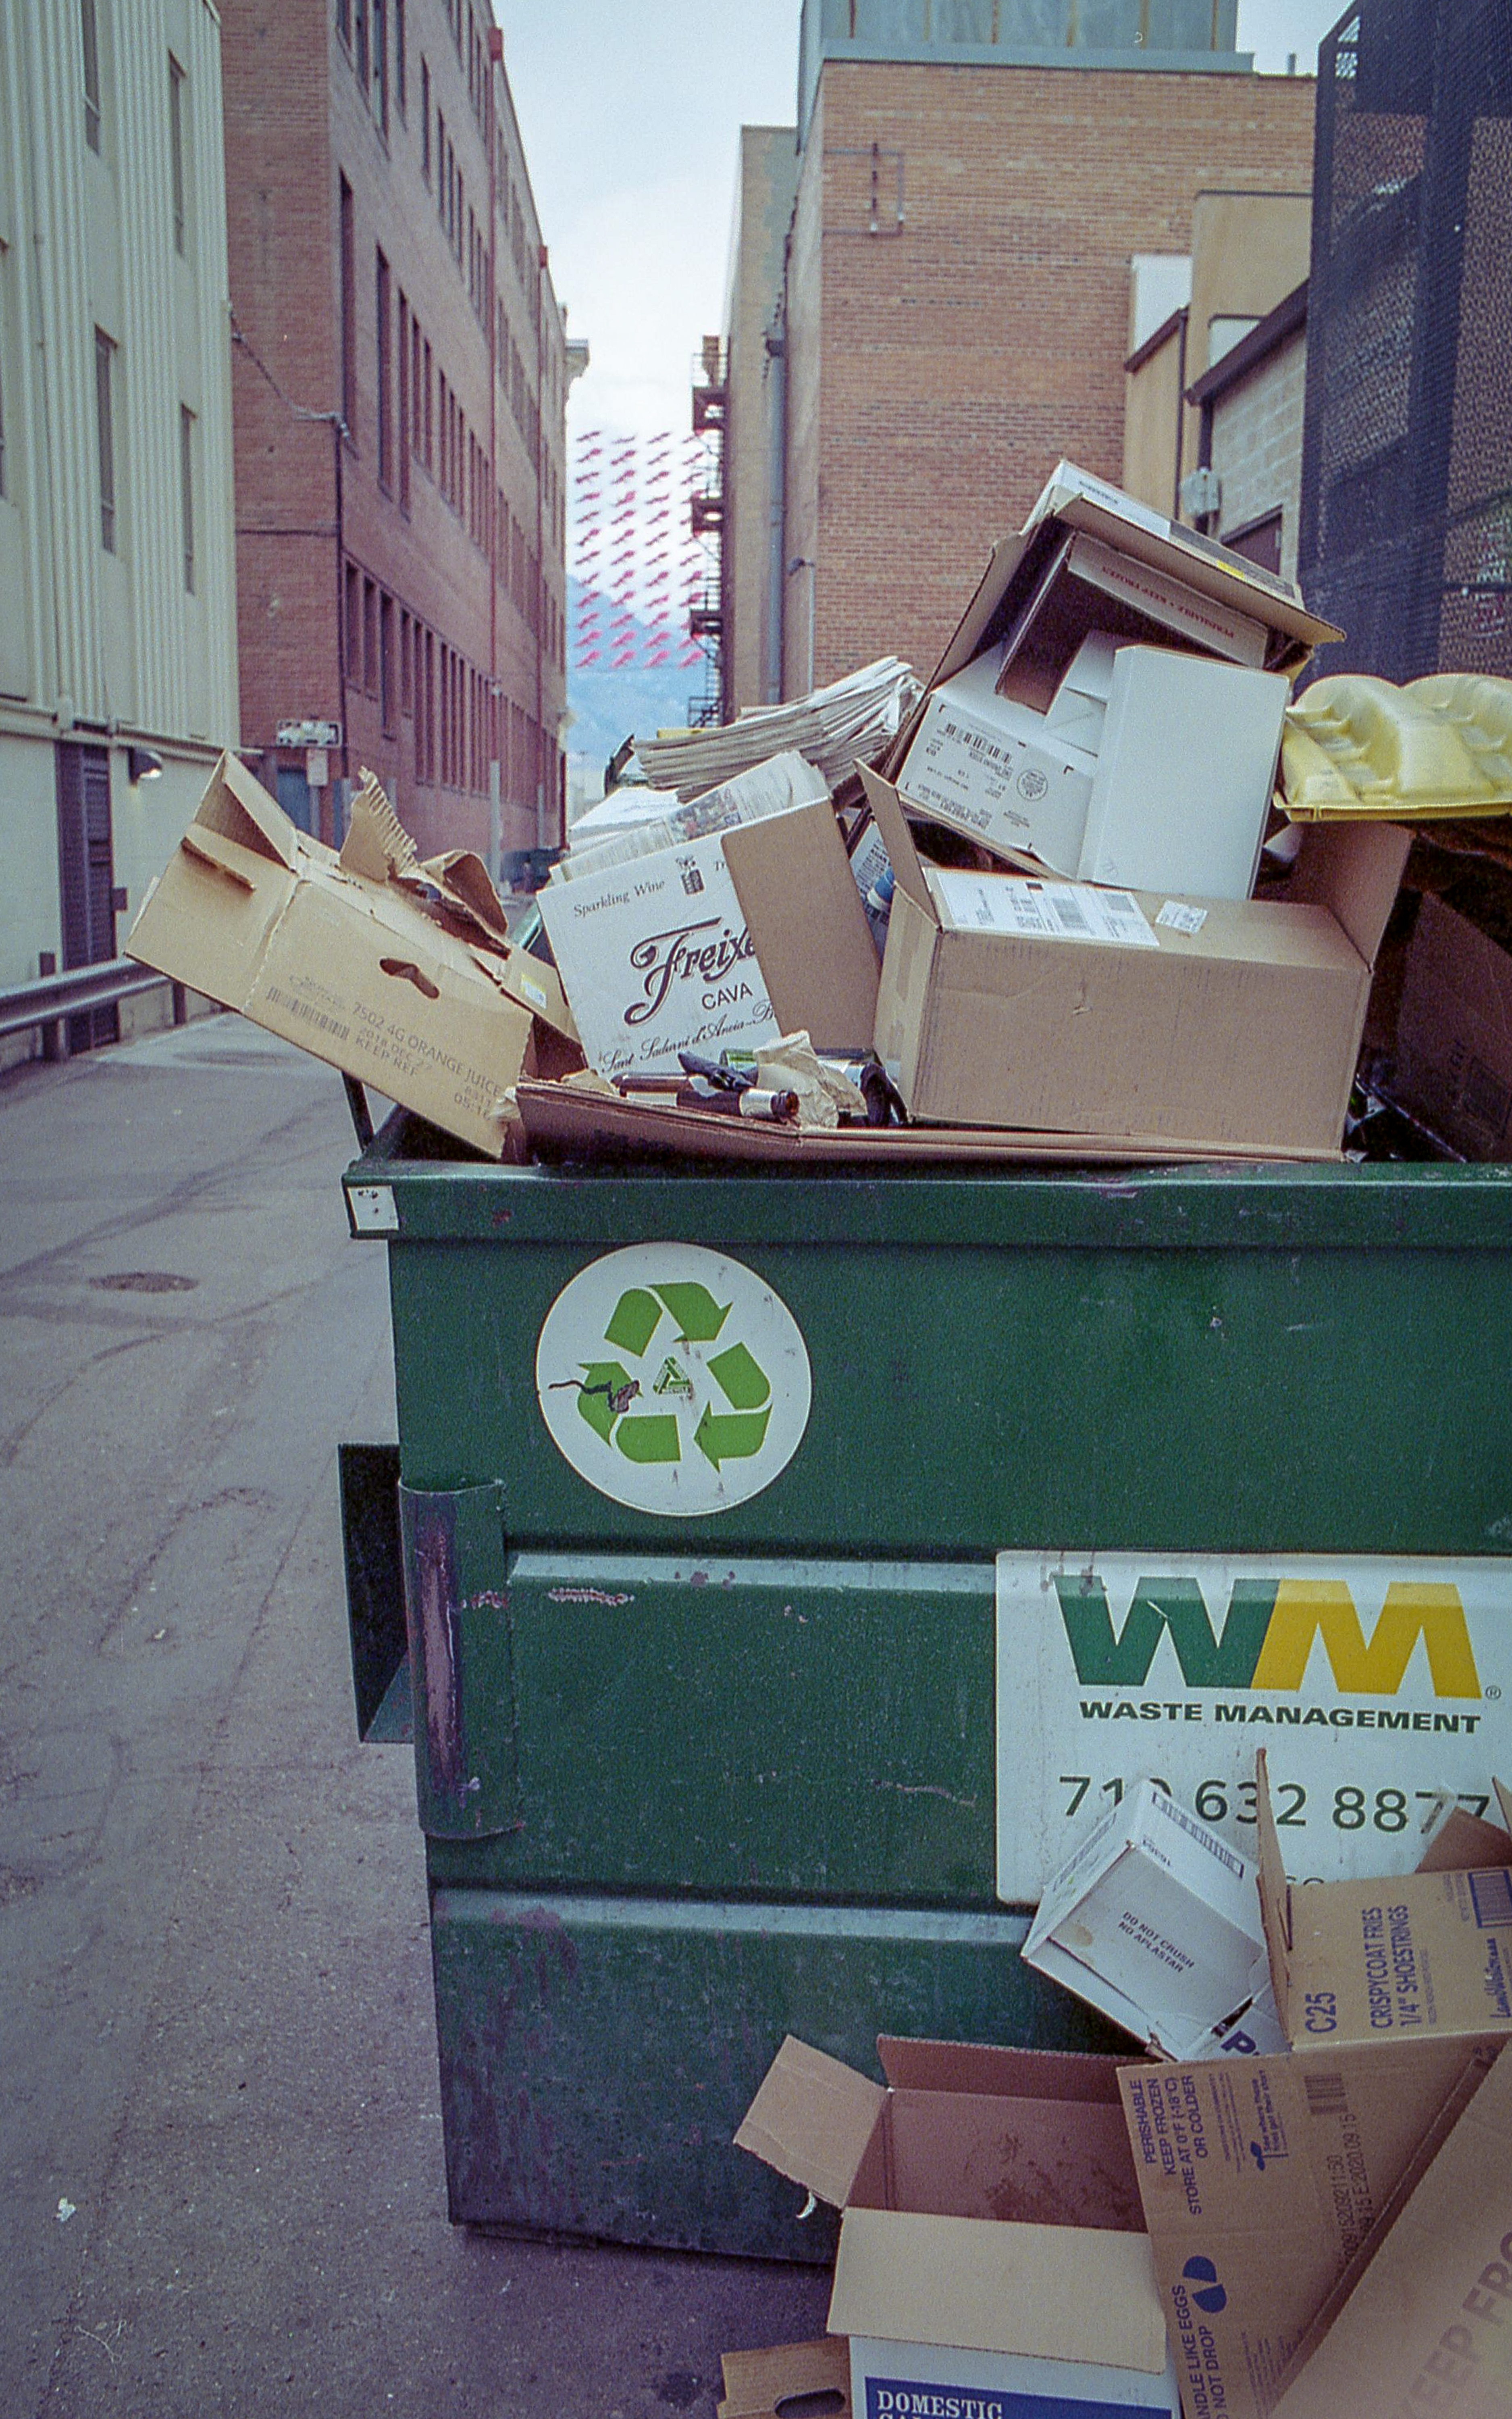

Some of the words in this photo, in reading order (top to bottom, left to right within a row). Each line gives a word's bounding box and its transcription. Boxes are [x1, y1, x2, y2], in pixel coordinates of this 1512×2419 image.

[574, 891, 630, 918] Sparkling
[633, 879, 666, 897] Wine
[624, 916, 755, 1025] Freixe
[702, 982, 753, 1009] CAVA
[351, 1002, 385, 1030] 7502
[385, 1023, 407, 1042] 4G
[406, 1035, 466, 1076] ORANGE
[463, 1068, 501, 1097] JUICE
[1053, 1575, 1482, 1699] WM
[1080, 1701, 1202, 1722] WASTE
[1215, 1704, 1481, 1734] MANAGEMENT
[1195, 1780, 1306, 1826] 632
[1333, 1786, 1490, 1834] 8877
[1122, 1911, 1140, 1926] DO
[1138, 1922, 1159, 1941] NOT
[1159, 1938, 1195, 1968] CRUSH
[1362, 1907, 1383, 1939] FRIES
[1117, 1921, 1135, 1935] NO
[1133, 1932, 1184, 1973] APLASTAR
[1388, 1904, 1418, 1993] SHOESTRINGS
[1364, 1941, 1393, 2029] CRISPYCOAT
[1305, 1992, 1337, 2033] C25
[1129, 2079, 1156, 2163] PERISHABLE
[1146, 2078, 1168, 2134] FROZEN
[1181, 2075, 1203, 2134] COLDER
[1158, 2138, 1176, 2175] KEEP
[1177, 2146, 1192, 2164] AT
[1194, 2137, 1208, 2158] OR
[1181, 2167, 1202, 2215] STORE
[1171, 2284, 1192, 2330] EGGS
[1181, 2333, 1200, 2369] LIKE
[1199, 2325, 1219, 2371] DROP
[1208, 2374, 1226, 2408] NOT
[1400, 2324, 1482, 2419] EEP
[877, 2390, 1002, 2419] DOMESTIC
[1189, 2373, 1210, 2419] NDLE
